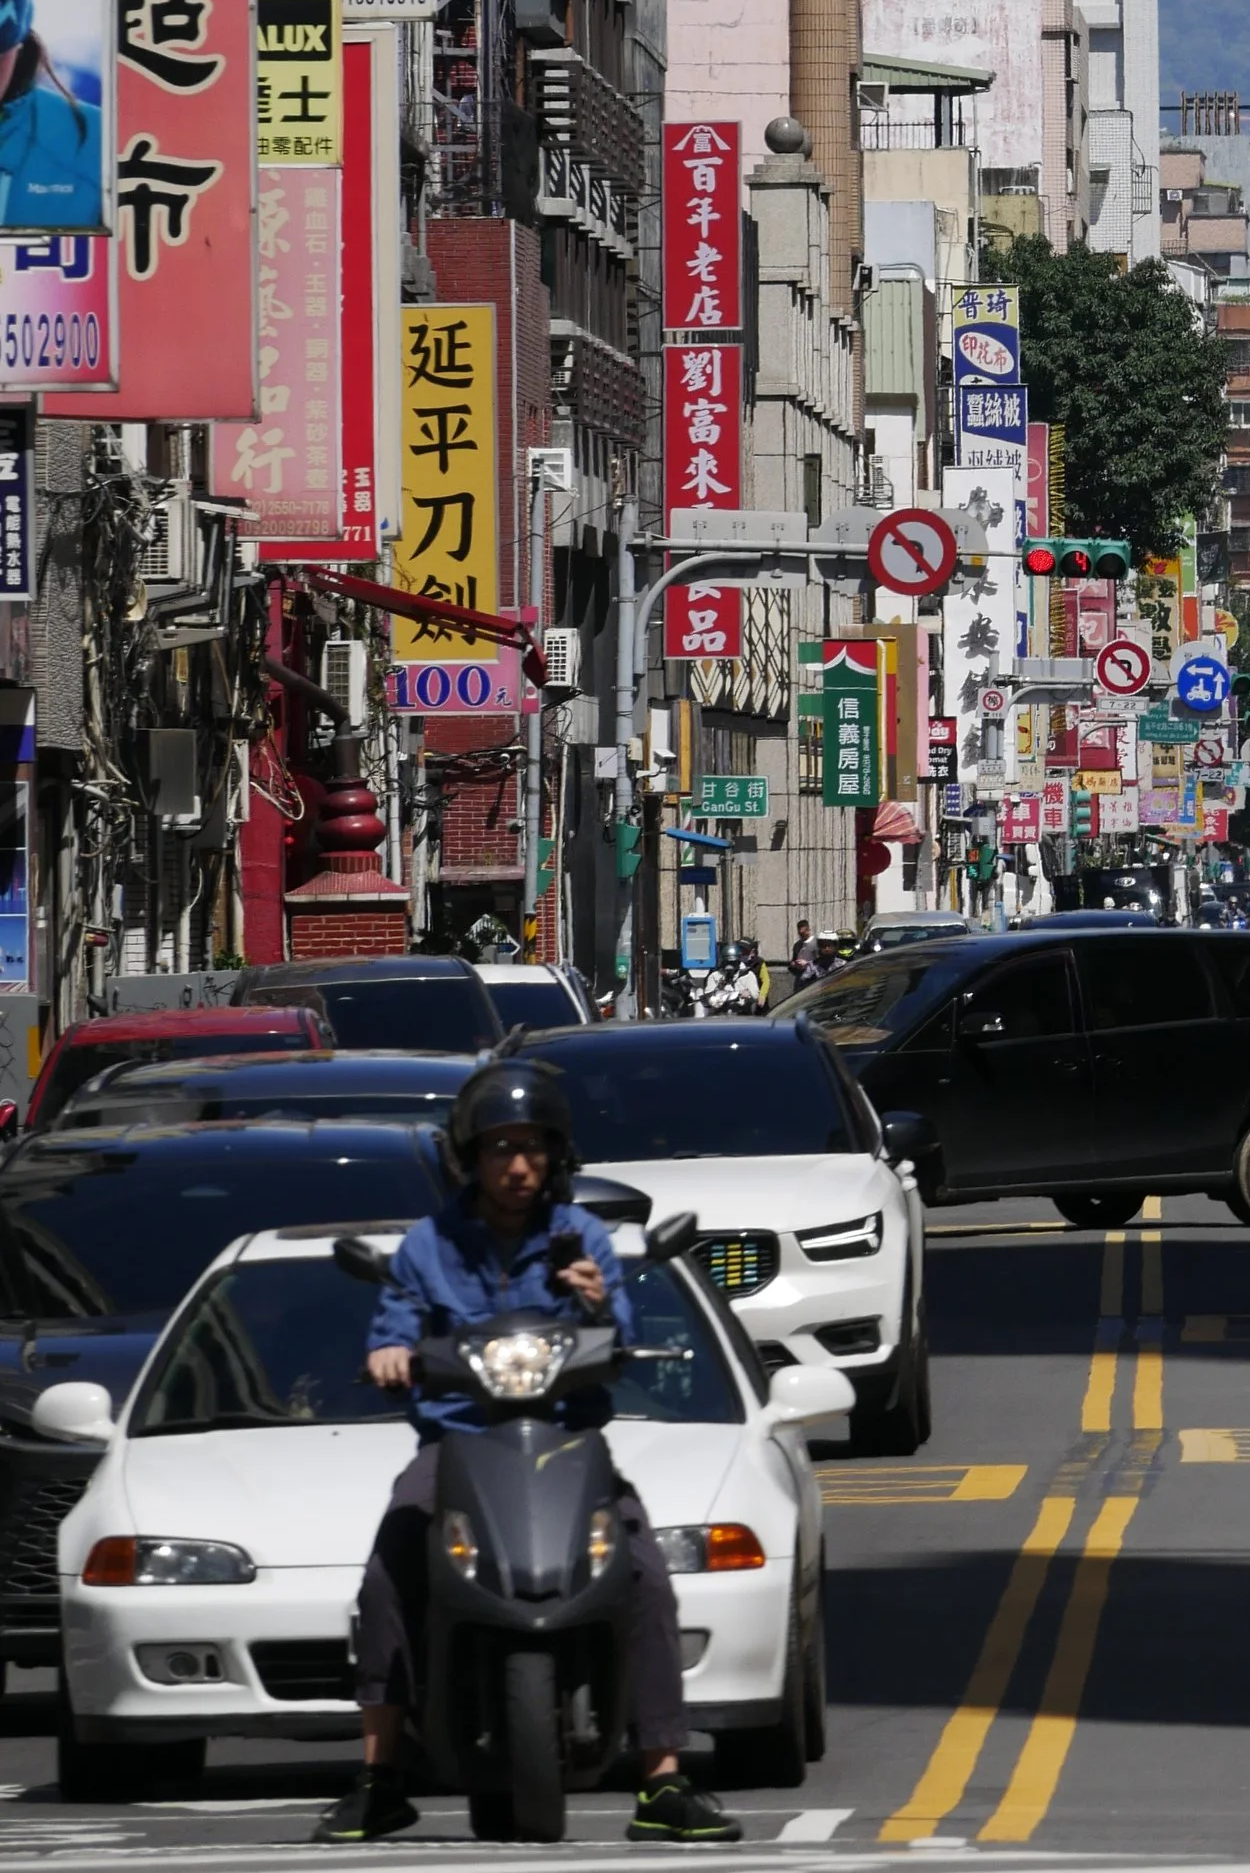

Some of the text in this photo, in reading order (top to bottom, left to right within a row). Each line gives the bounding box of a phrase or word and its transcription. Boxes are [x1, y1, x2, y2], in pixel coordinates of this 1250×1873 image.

[683, 156, 724, 326] 百年老店
[837, 697, 861, 796] 信義房屋
[702, 781, 765, 799] 甘谷街
[702, 800, 741, 813] GanGu
